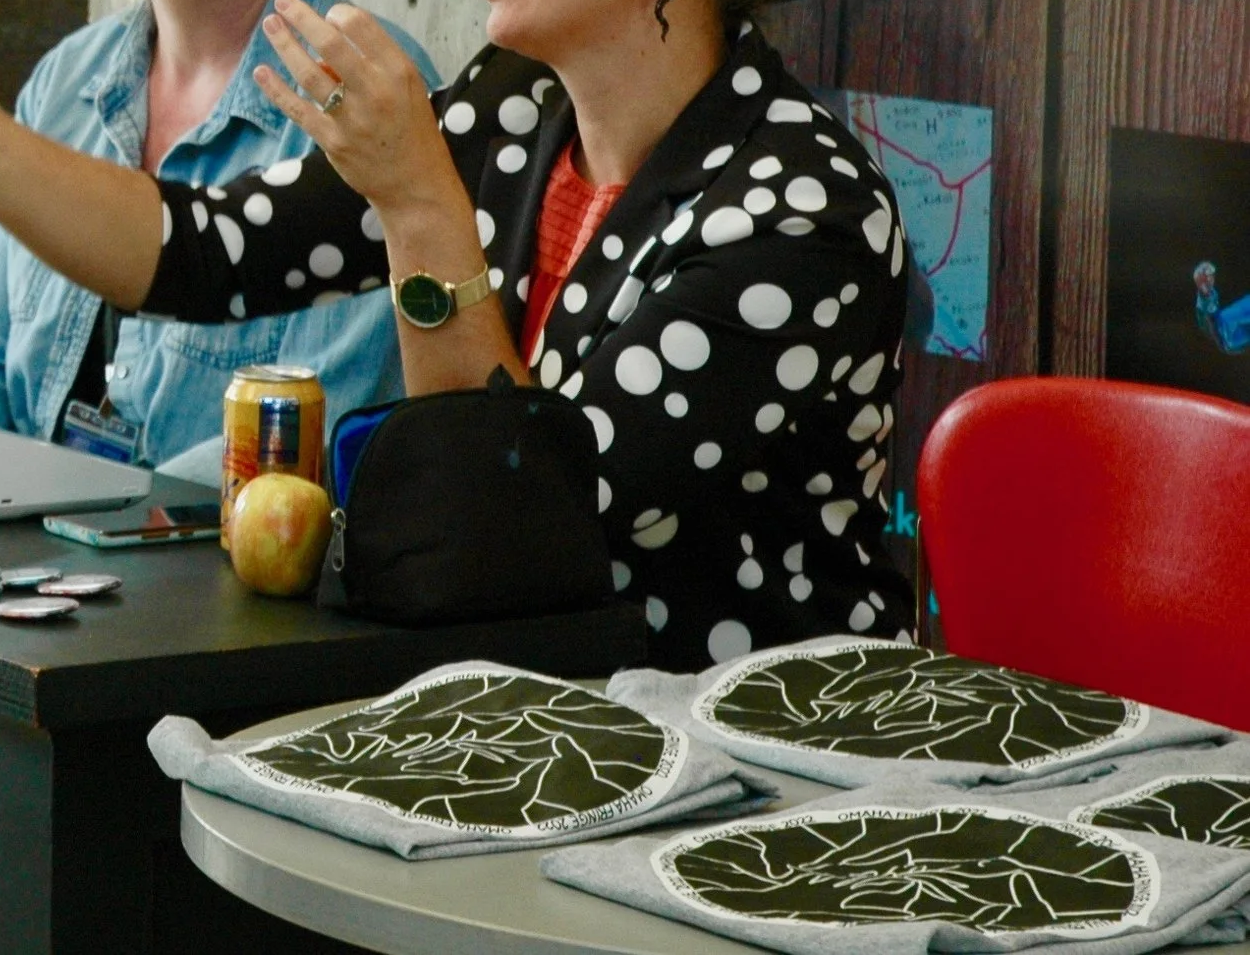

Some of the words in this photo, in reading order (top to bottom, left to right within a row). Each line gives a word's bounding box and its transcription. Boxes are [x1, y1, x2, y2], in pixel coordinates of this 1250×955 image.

[612, 786, 653, 815] OMAHA
[572, 804, 614, 828] FRINGE
[782, 814, 814, 829] 2022
[838, 809, 892, 821] OMAHA
